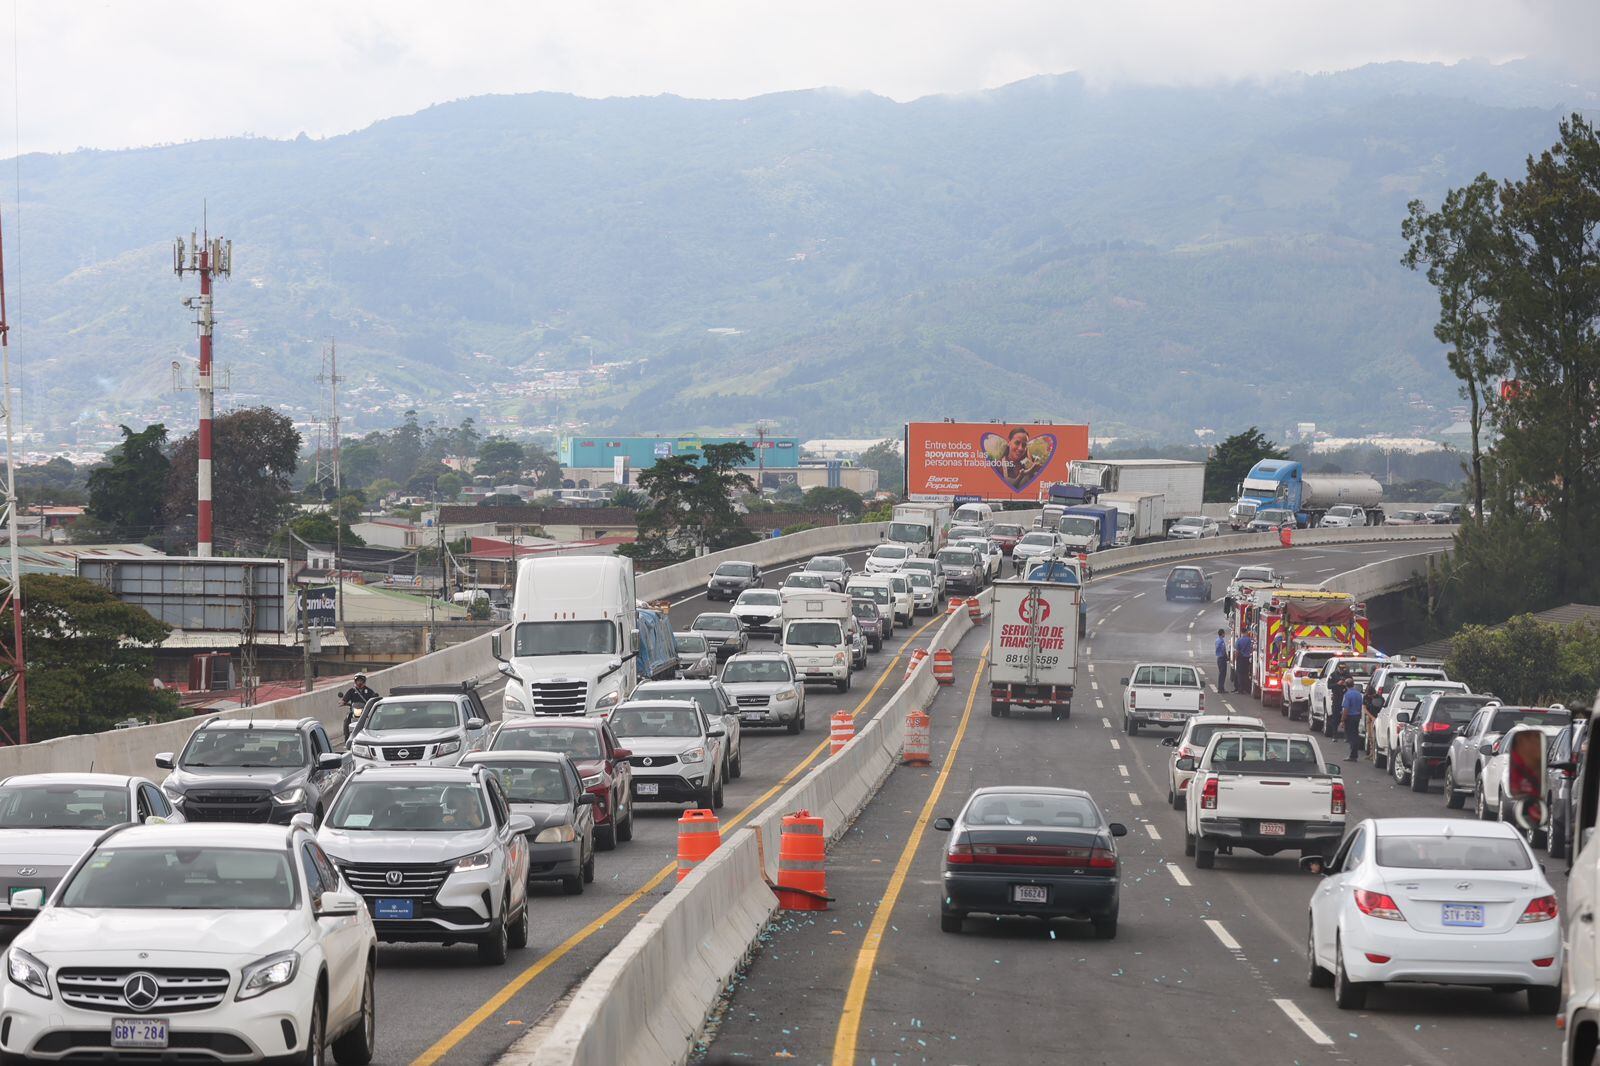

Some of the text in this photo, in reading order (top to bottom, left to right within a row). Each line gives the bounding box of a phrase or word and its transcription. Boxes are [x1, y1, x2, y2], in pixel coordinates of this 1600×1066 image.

[925, 440, 972, 450] Entre todos
[925, 450, 969, 459] apoyamos
[976, 449, 988, 459] las
[925, 458, 1016, 468] personas trabajadoras.
[925, 482, 960, 490] Popular
[1050, 626, 1064, 638] DE
[1000, 636, 1065, 649] TRANSPORTE
[115, 1025, 165, 1040] GBY-284
